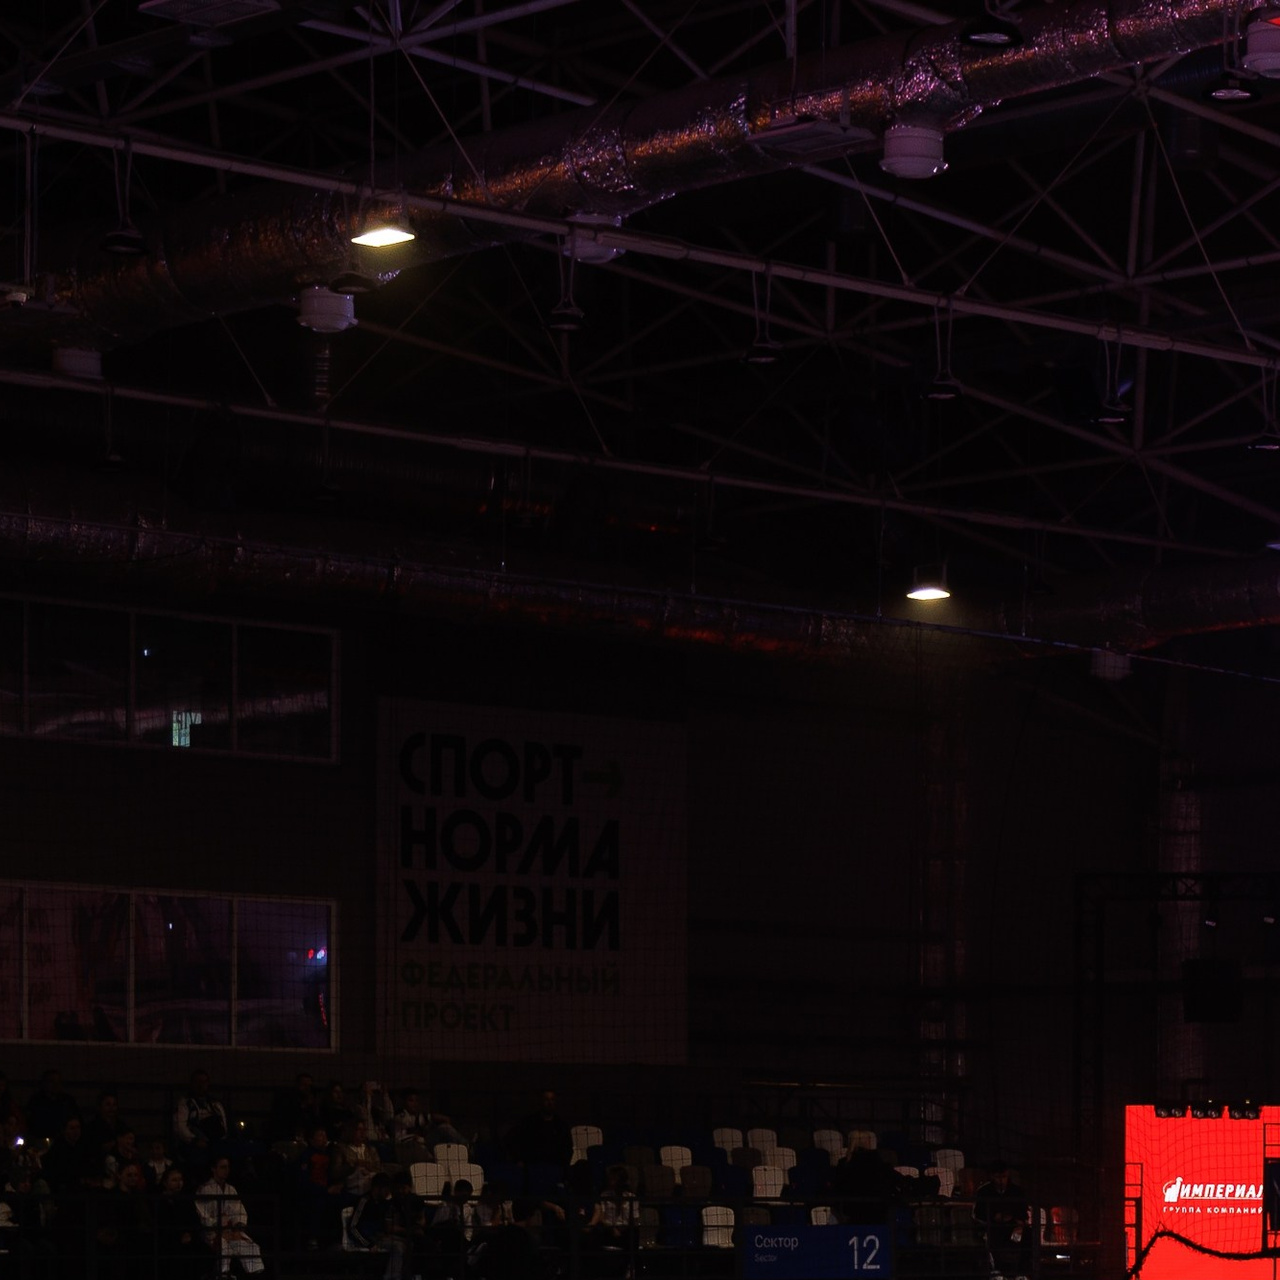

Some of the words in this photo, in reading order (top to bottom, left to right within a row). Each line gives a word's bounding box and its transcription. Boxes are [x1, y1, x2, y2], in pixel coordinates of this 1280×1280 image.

[399, 732, 583, 805] СПОРТ
[401, 805, 620, 879] НОРМА
[400, 879, 620, 951] ЖИЗНИ
[401, 959, 620, 998] ФЕДЕРАЛЬНЫЙ
[402, 1001, 515, 1031] ПРОЕКТ
[1163, 1206, 1202, 1214] ГРУППА
[754, 1234, 799, 1251] Сектор
[848, 1234, 881, 1270] 12
